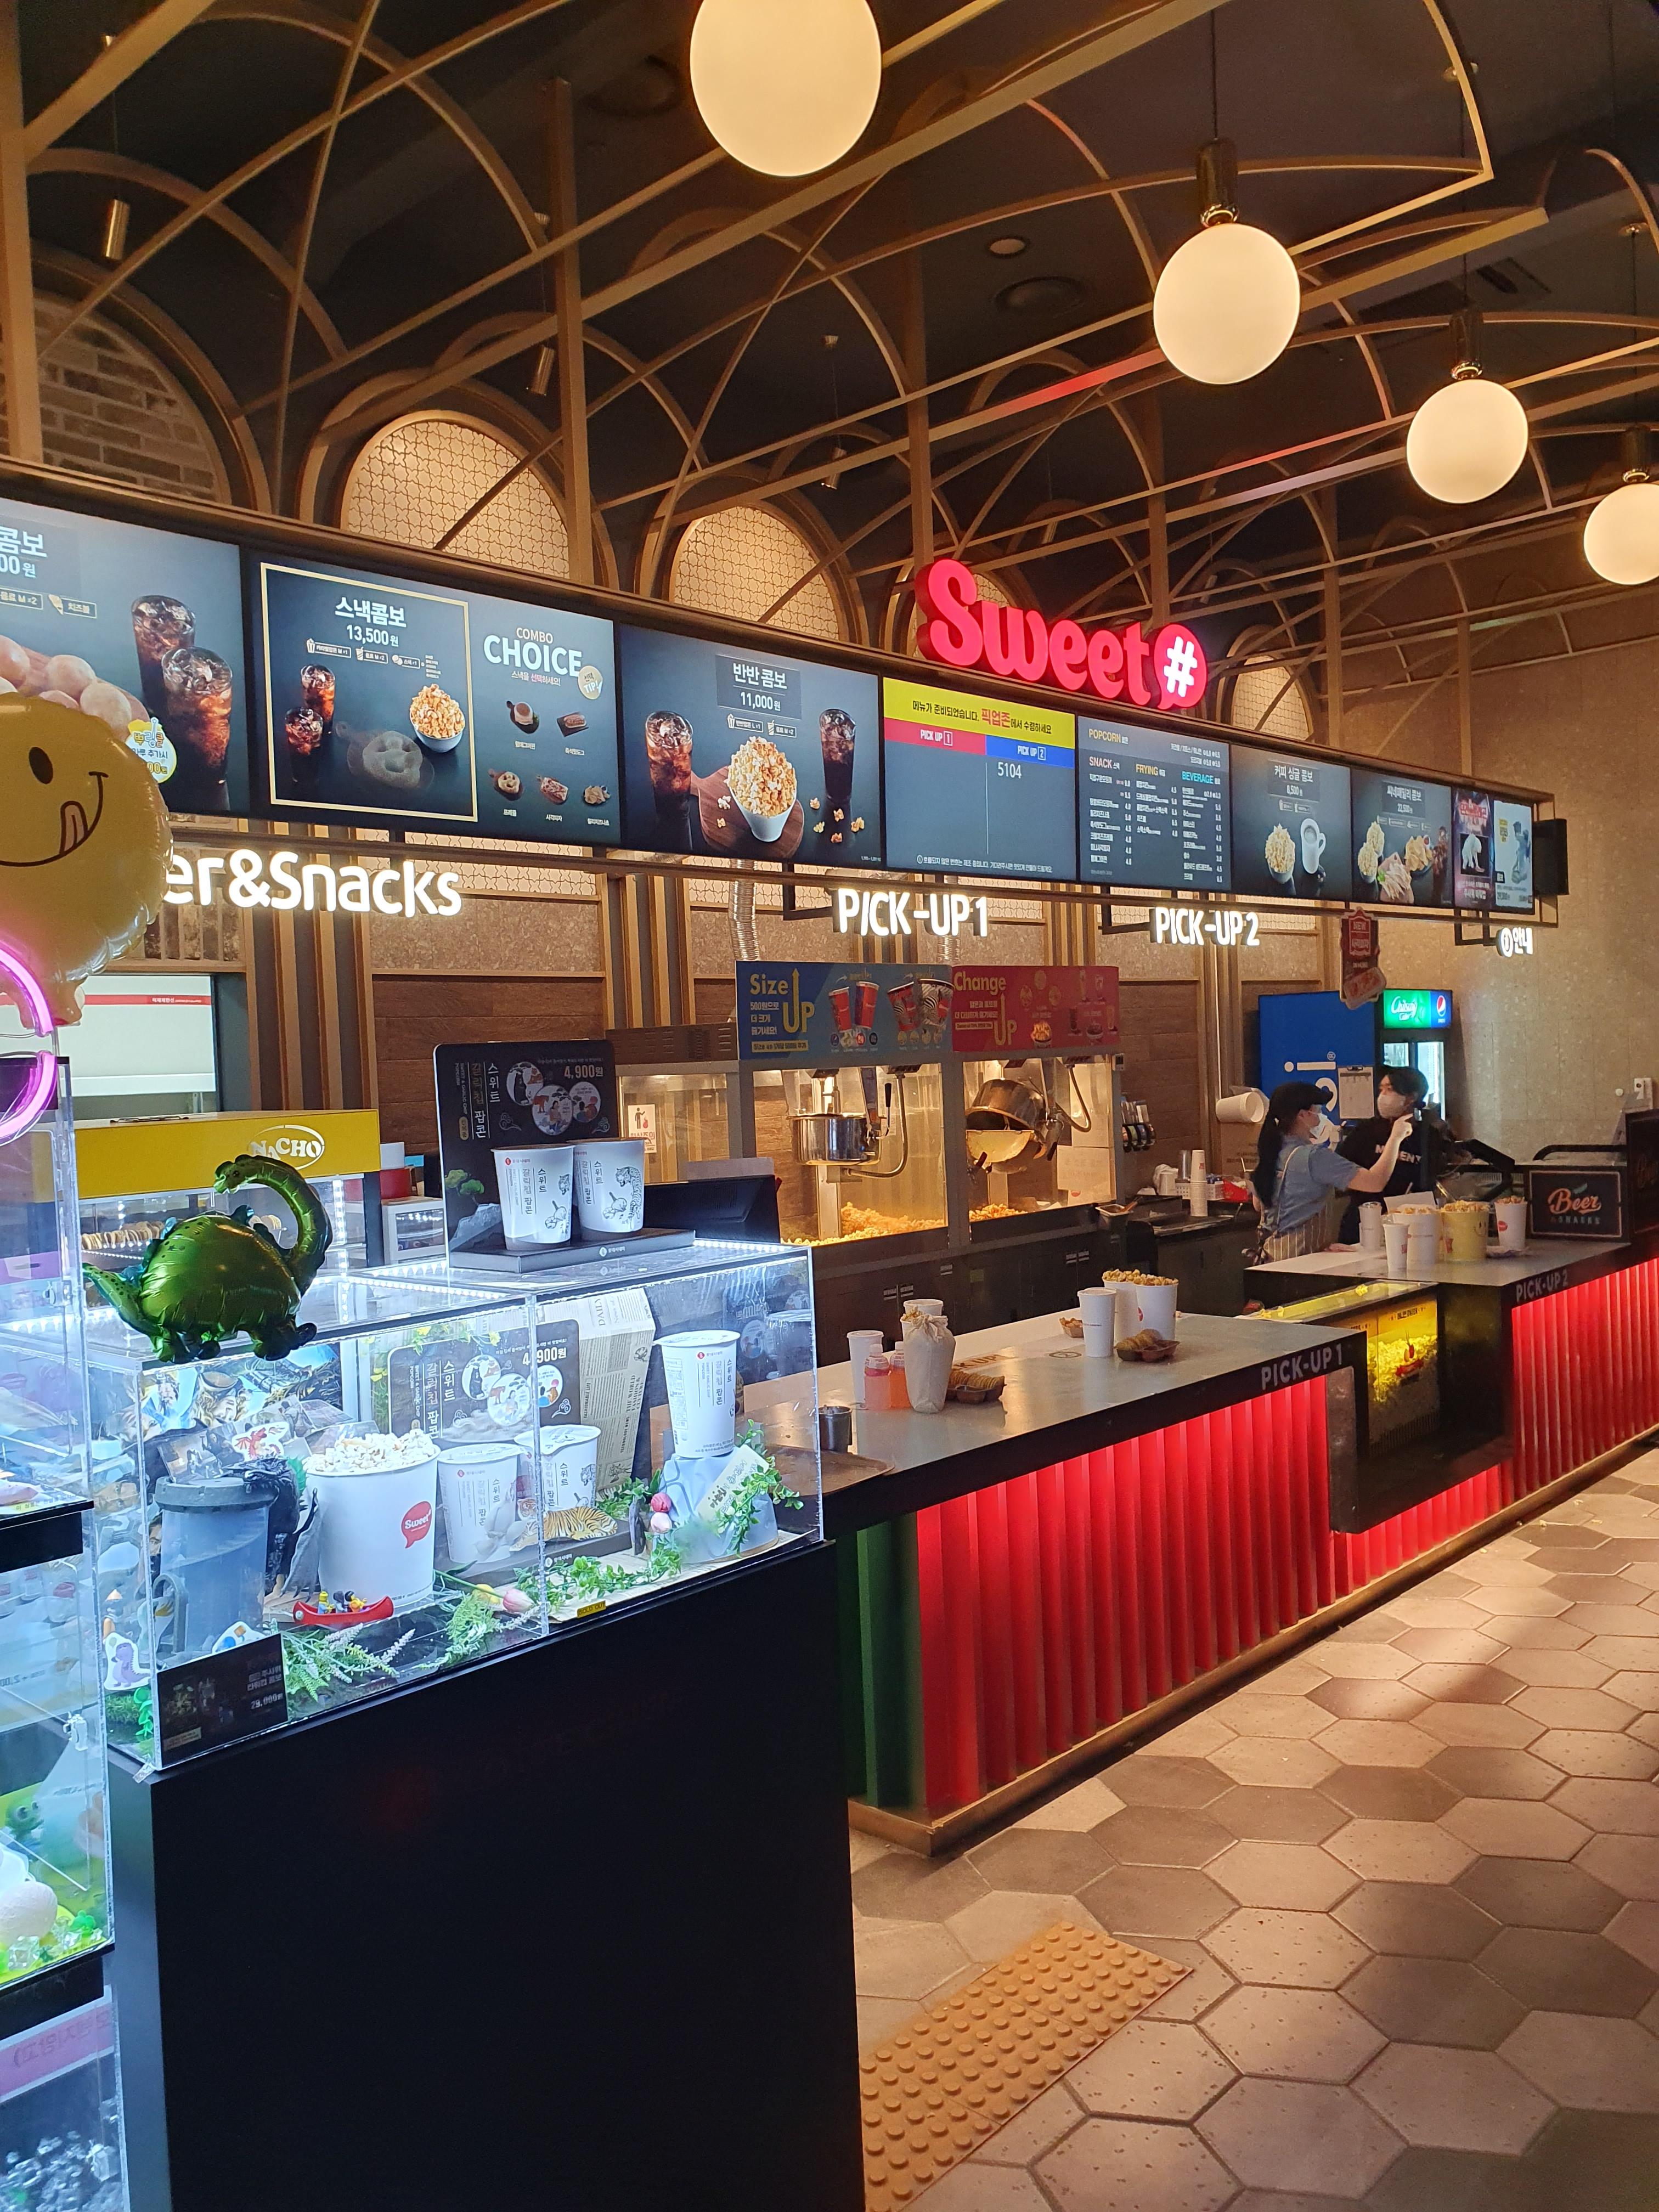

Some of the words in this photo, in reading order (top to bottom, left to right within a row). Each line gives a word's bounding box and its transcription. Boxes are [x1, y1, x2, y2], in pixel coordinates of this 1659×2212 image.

[335, 596, 407, 628] 스낵콤보
[346, 624, 399, 647] 13,500원
[516, 627, 554, 644] COMBO
[915, 558, 1151, 707] Sweet
[483, 635, 582, 678] CHOICE
[511, 670, 529, 681] 스낵을
[531, 673, 561, 686] 선택하세요!
[733, 663, 760, 685] 반반
[761, 668, 787, 689] 콤보
[583, 680, 599, 693] TIP!
[741, 692, 781, 712] 11,000원
[913, 701, 932, 713] 메뉴가
[934, 704, 979, 721] 준비되었습니다.
[981, 708, 1022, 729] 픽업존에서
[1024, 719, 1052, 734] 수령하세요
[920, 729, 933, 741] PICK
[935, 731, 943, 742] UP
[1088, 728, 1121, 743] POPCORN
[148, 749, 168, 759] 추가시
[1017, 745, 1029, 756] PICK
[1030, 748, 1037, 757] UP
[997, 761, 1022, 778] 5104
[1089, 756, 1113, 769] SNACK
[1136, 764, 1159, 776] FRYING
[1182, 771, 1214, 785] BEVERAGE
[1274, 765, 1286, 779] 커피
[1288, 766, 1300, 781] 싱글
[750, 973, 788, 995] Size
[953, 970, 1007, 996] Change
[751, 1014, 757, 1023] 더
[758, 1014, 771, 1023] 크기
[564, 1064, 603, 1080] 4,900원
[488, 1063, 500, 1103] 스위트
[474, 1110, 487, 1139] 팝콘
[250, 1137, 322, 1160] NACHO
[523, 1169, 532, 1194] 갈릭칩
[538, 1168, 548, 1193] 스위트
[594, 1161, 603, 1184] 스위트
[524, 1197, 533, 1215] 팝콘
[585, 1188, 592, 1205] 팝콘
[1548, 1187, 1602, 1215] Beer
[1516, 1272, 1560, 1304] PICK-UP
[1562, 1268, 1569, 1287] 2
[522, 1346, 567, 1365] 4900원
[1261, 1346, 1332, 1391] PICK-UP
[1336, 1343, 1342, 1365] 1
[443, 1360, 455, 1402] 스위트
[716, 1388, 724, 1406] 팝콘
[427, 1410, 439, 1440] 팝콘
[560, 1462, 568, 1486] 스위트
[547, 1490, 556, 1507] 팝콘
[404, 1513, 429, 1530] Sweet
